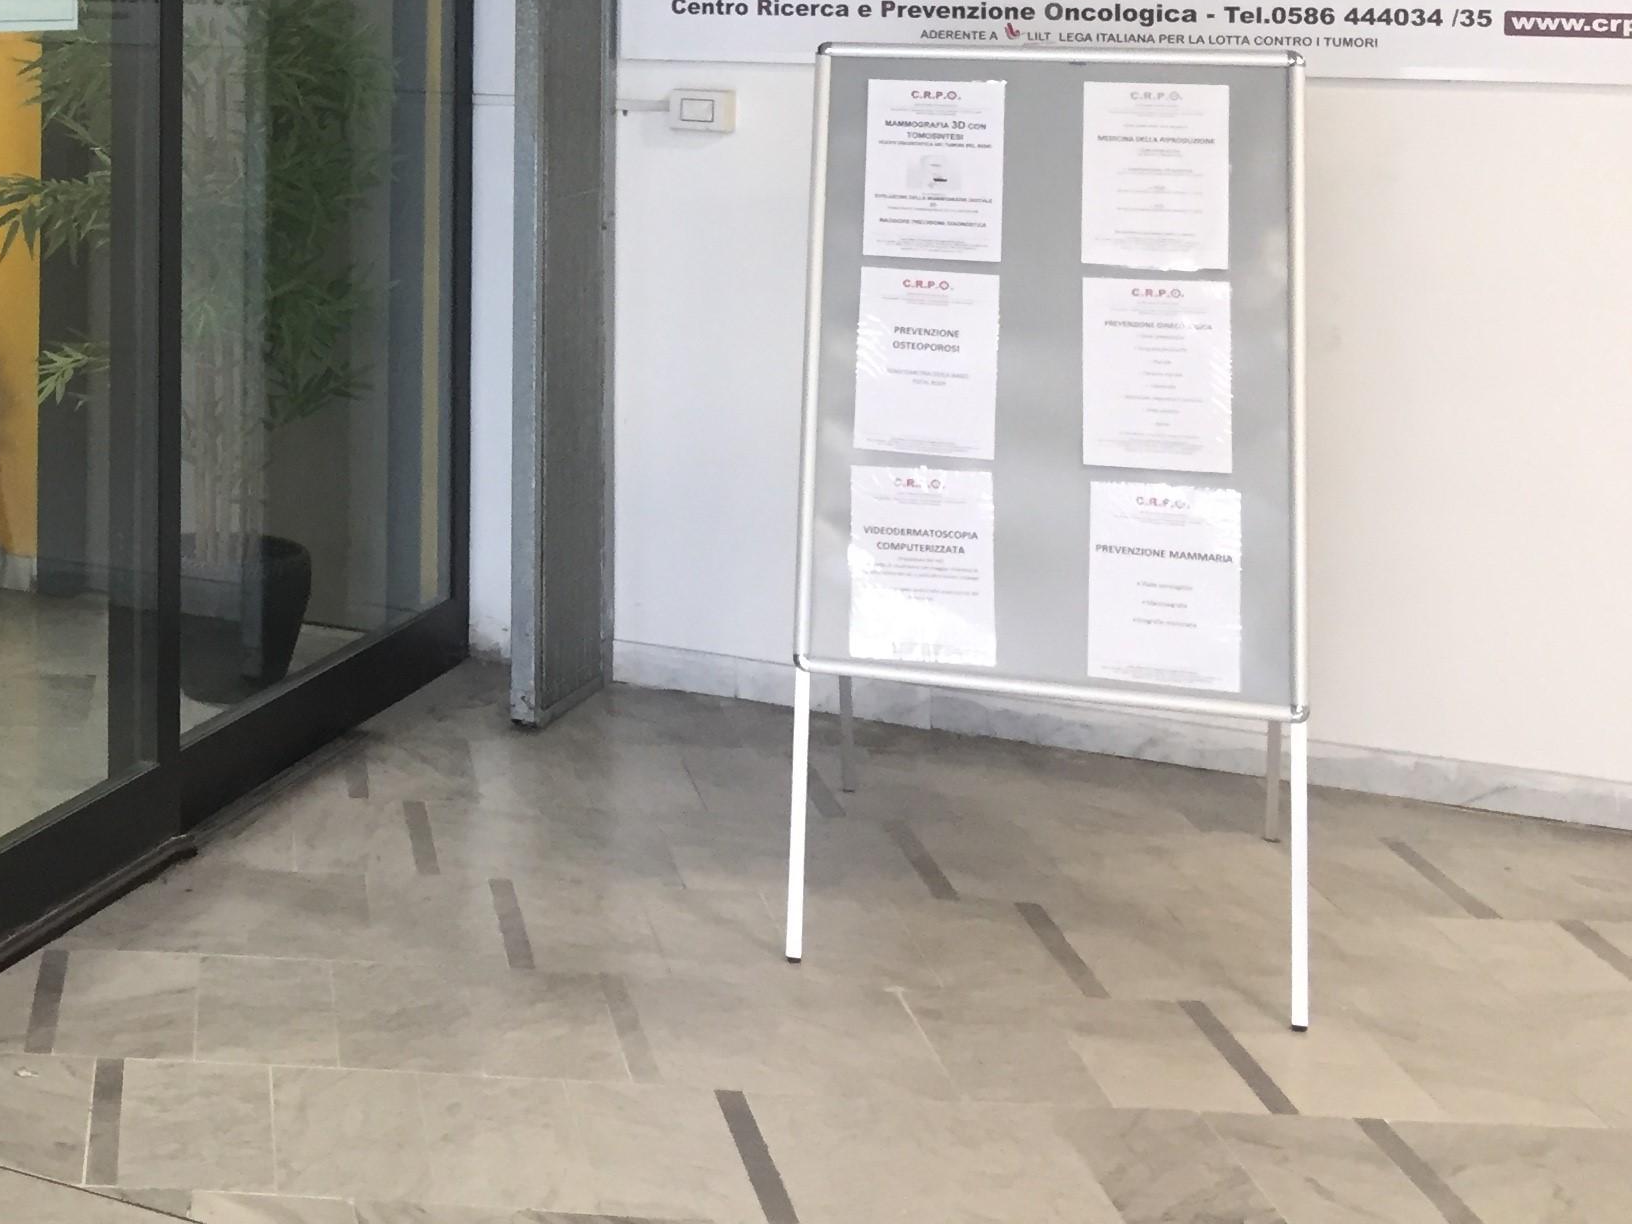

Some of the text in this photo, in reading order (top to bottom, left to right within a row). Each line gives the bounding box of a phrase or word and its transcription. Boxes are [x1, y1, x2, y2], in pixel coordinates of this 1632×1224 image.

[757, 0, 849, 17] Ricerca
[858, 5, 872, 17] e
[881, 1, 1035, 20] Prevenzione
[1045, 3, 1197, 27] Oncologica
[1224, 6, 1335, 25] Tel.0586
[1344, 8, 1443, 26] 444034
[1452, 9, 1492, 27] /35
[920, 30, 1378, 48] ADERENTE A LILT LEGA ITALIANA PER LA LOTTA CONTRO I TUMORI
[952, 121, 965, 129] 3D
[894, 326, 959, 338] PREVENZIONE
[893, 341, 960, 352] OSTEOPOROSI
[864, 525, 978, 539] VIDEODERMATOSCOPIA
[877, 541, 964, 554] COMPUTERIZZATA
[1096, 544, 1233, 563] PREVENZIONE MAMMARIA
